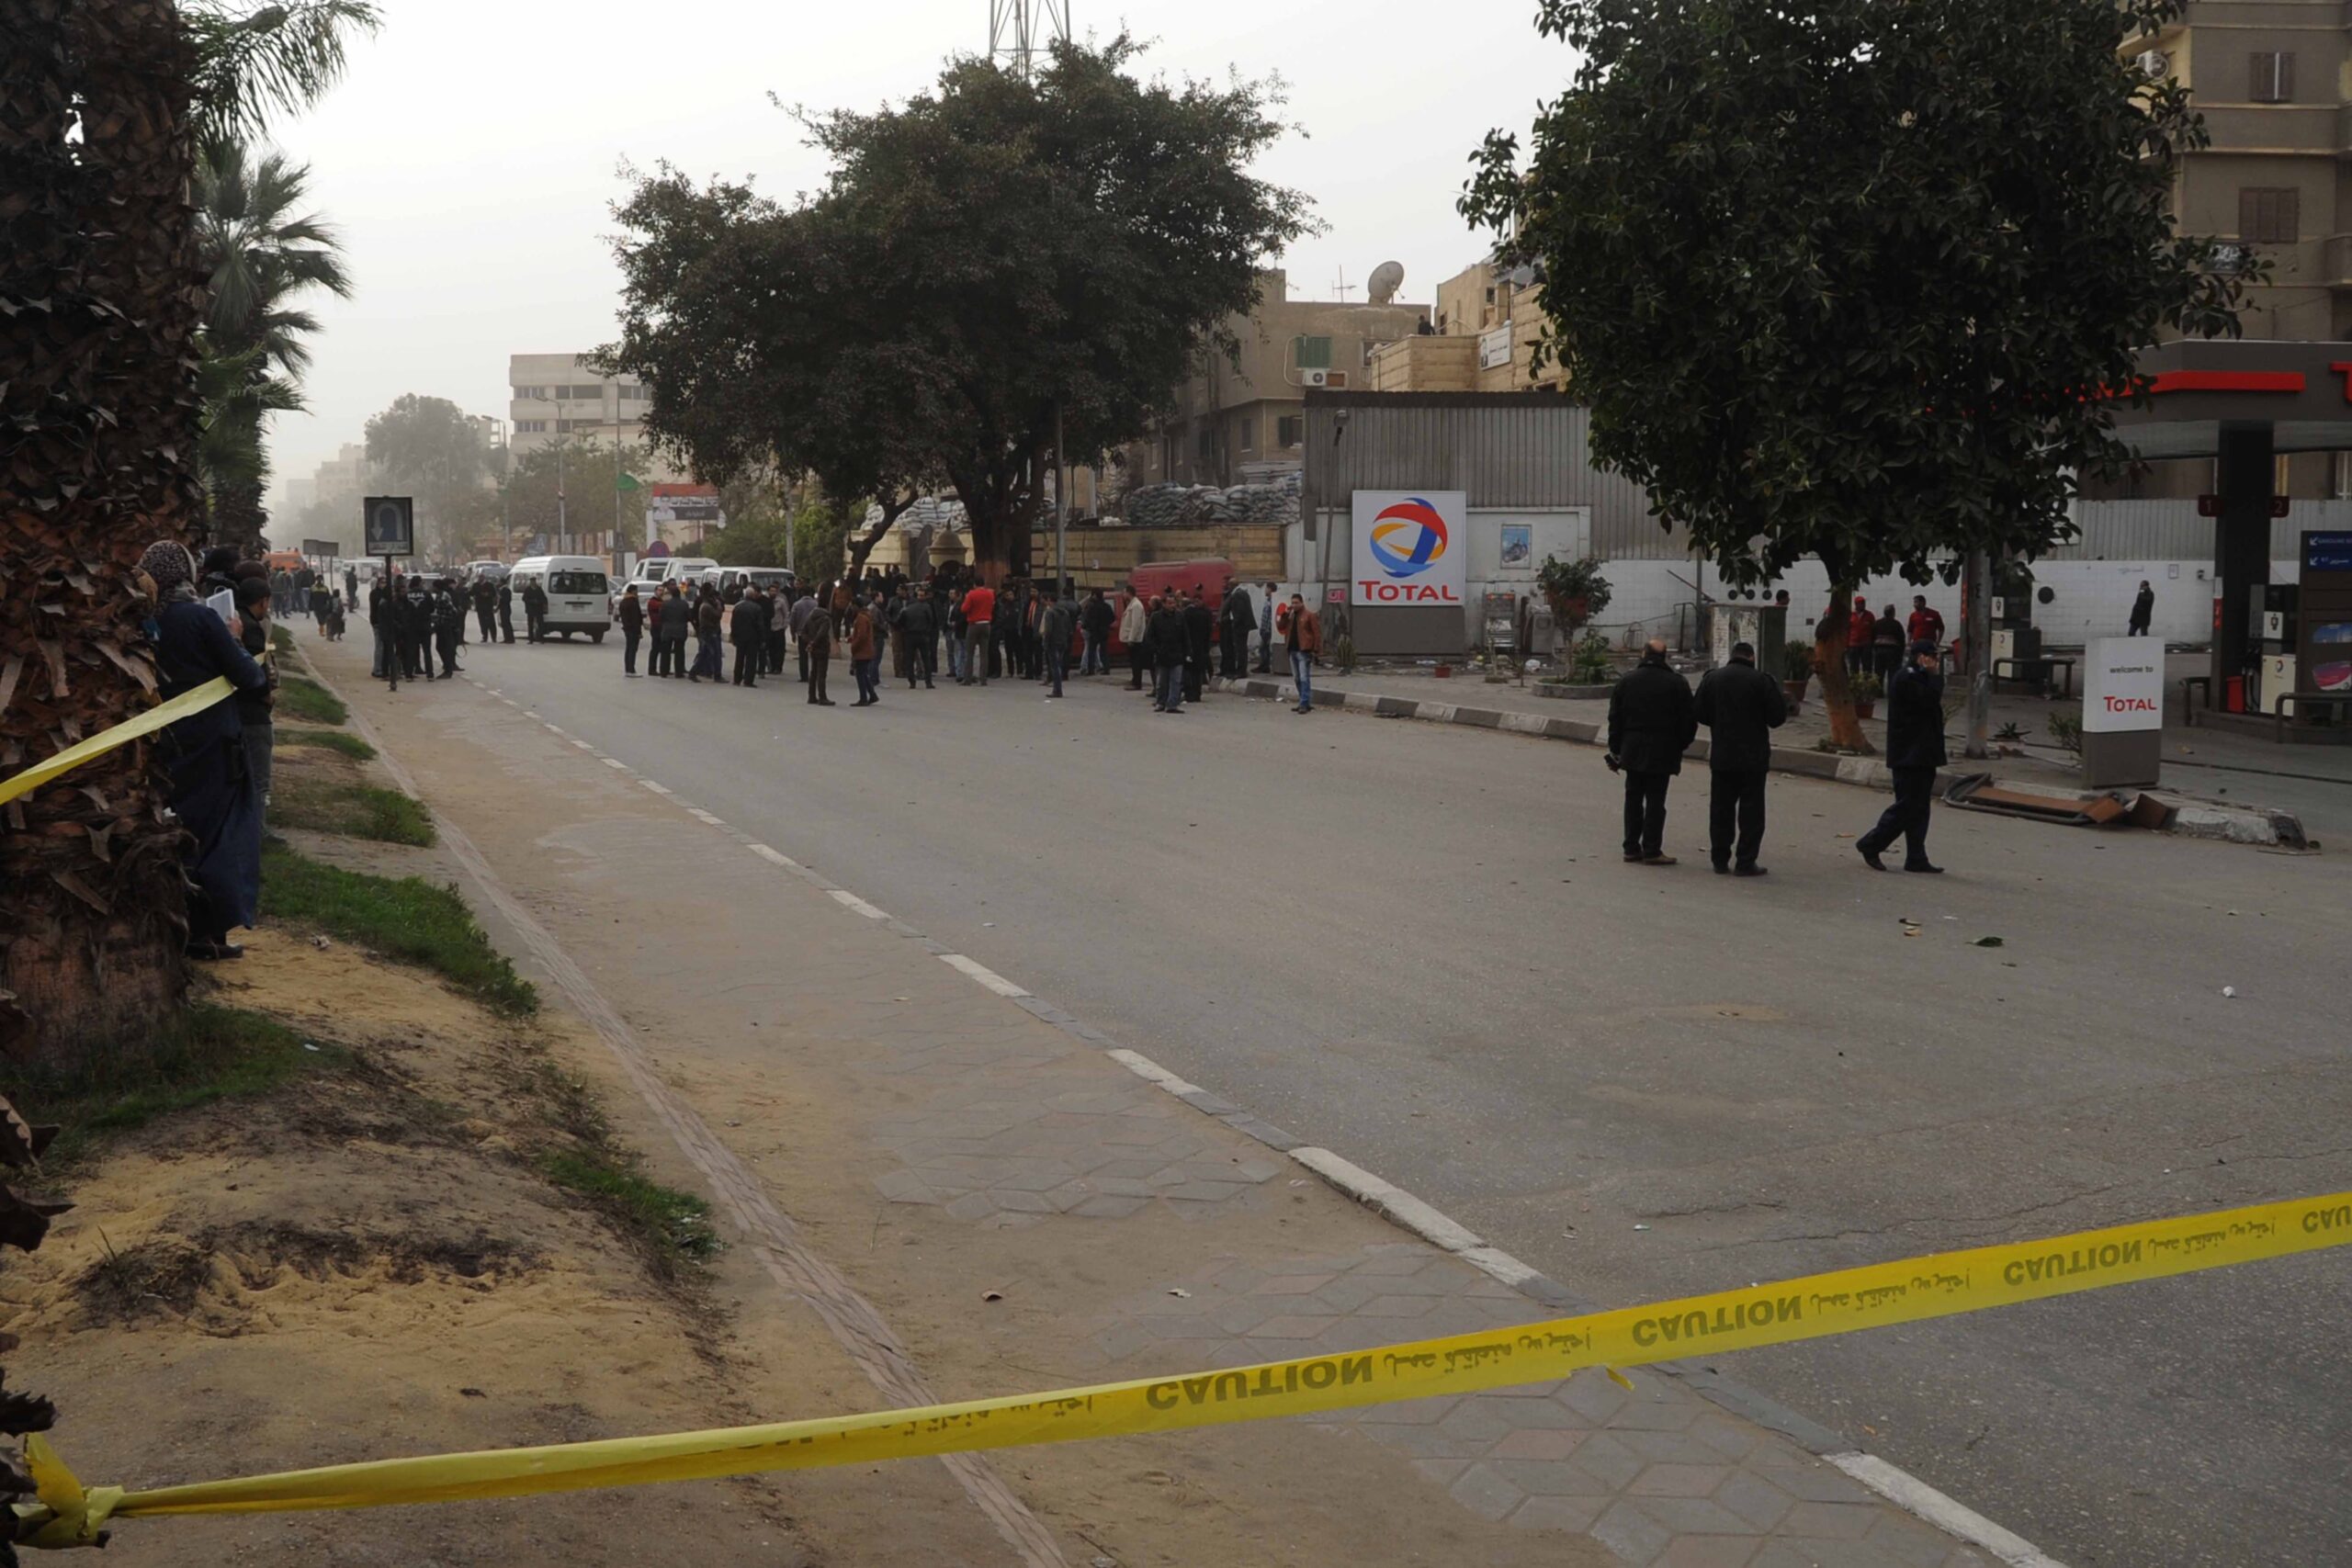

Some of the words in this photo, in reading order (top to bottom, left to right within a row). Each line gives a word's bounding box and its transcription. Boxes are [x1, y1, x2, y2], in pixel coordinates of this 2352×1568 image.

[2205, 499, 2212, 513] 1
[2274, 500, 2283, 514] 2
[1358, 581, 1460, 602] TOTAL
[2109, 665, 2143, 674] welcome
[2145, 665, 2154, 673] to
[2103, 695, 2157, 713] TOTAL
